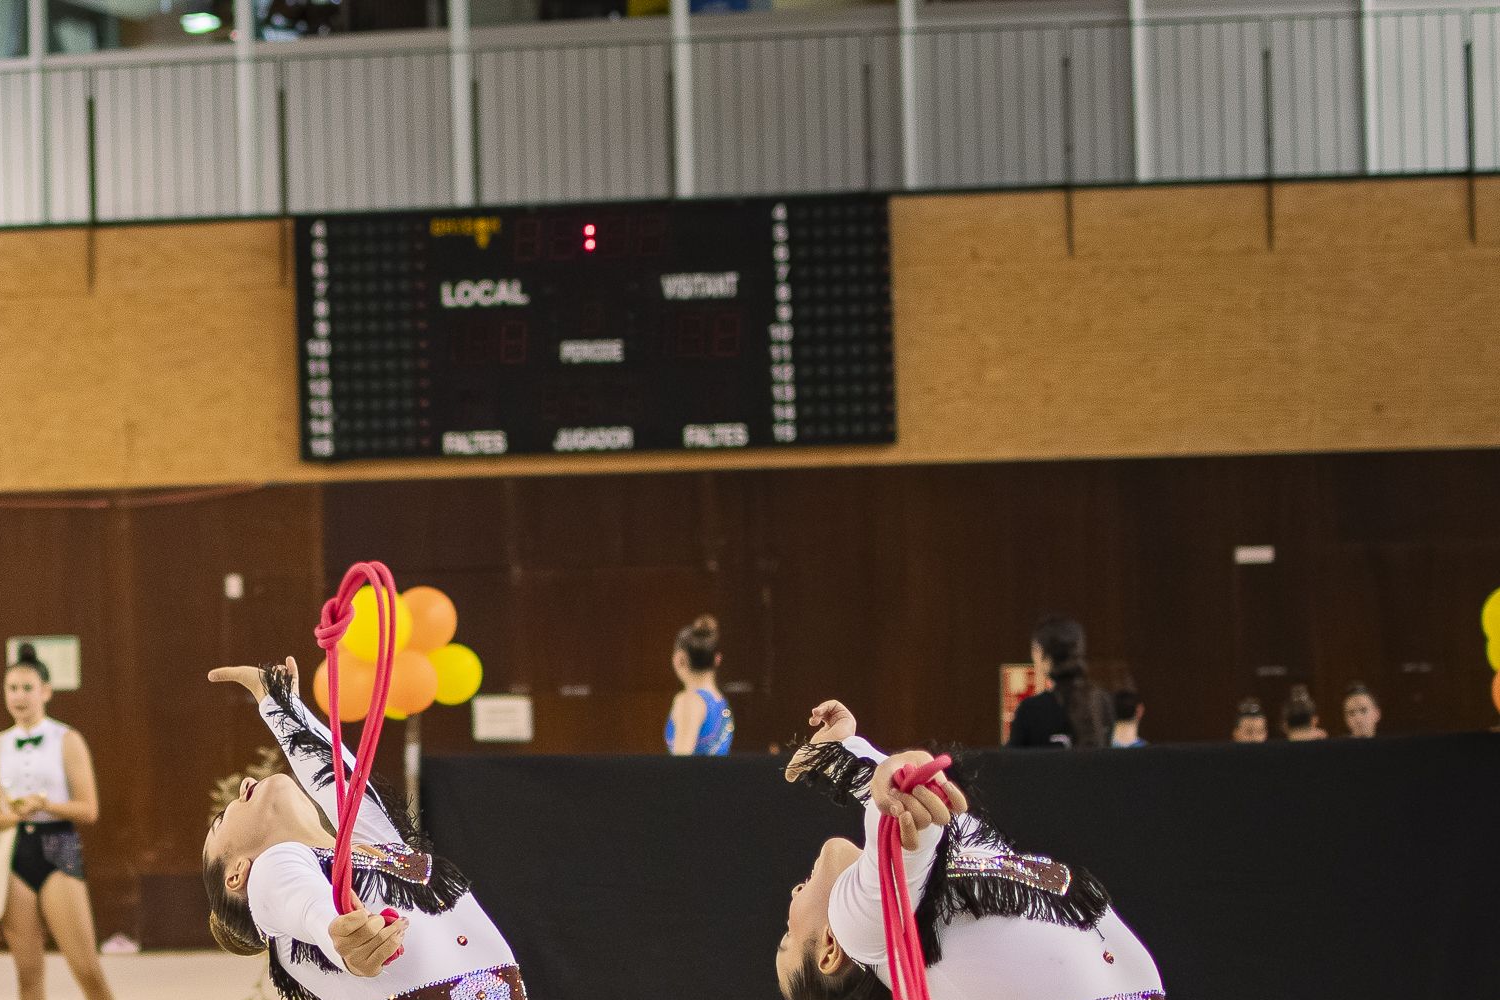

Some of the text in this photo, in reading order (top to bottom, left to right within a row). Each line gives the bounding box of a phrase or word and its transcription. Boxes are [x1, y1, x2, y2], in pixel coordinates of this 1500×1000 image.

[440, 279, 530, 307] LOCAL
[442, 430, 508, 455] FALTES
[553, 426, 635, 451] JUGADOR
[682, 422, 750, 447] FALTES
